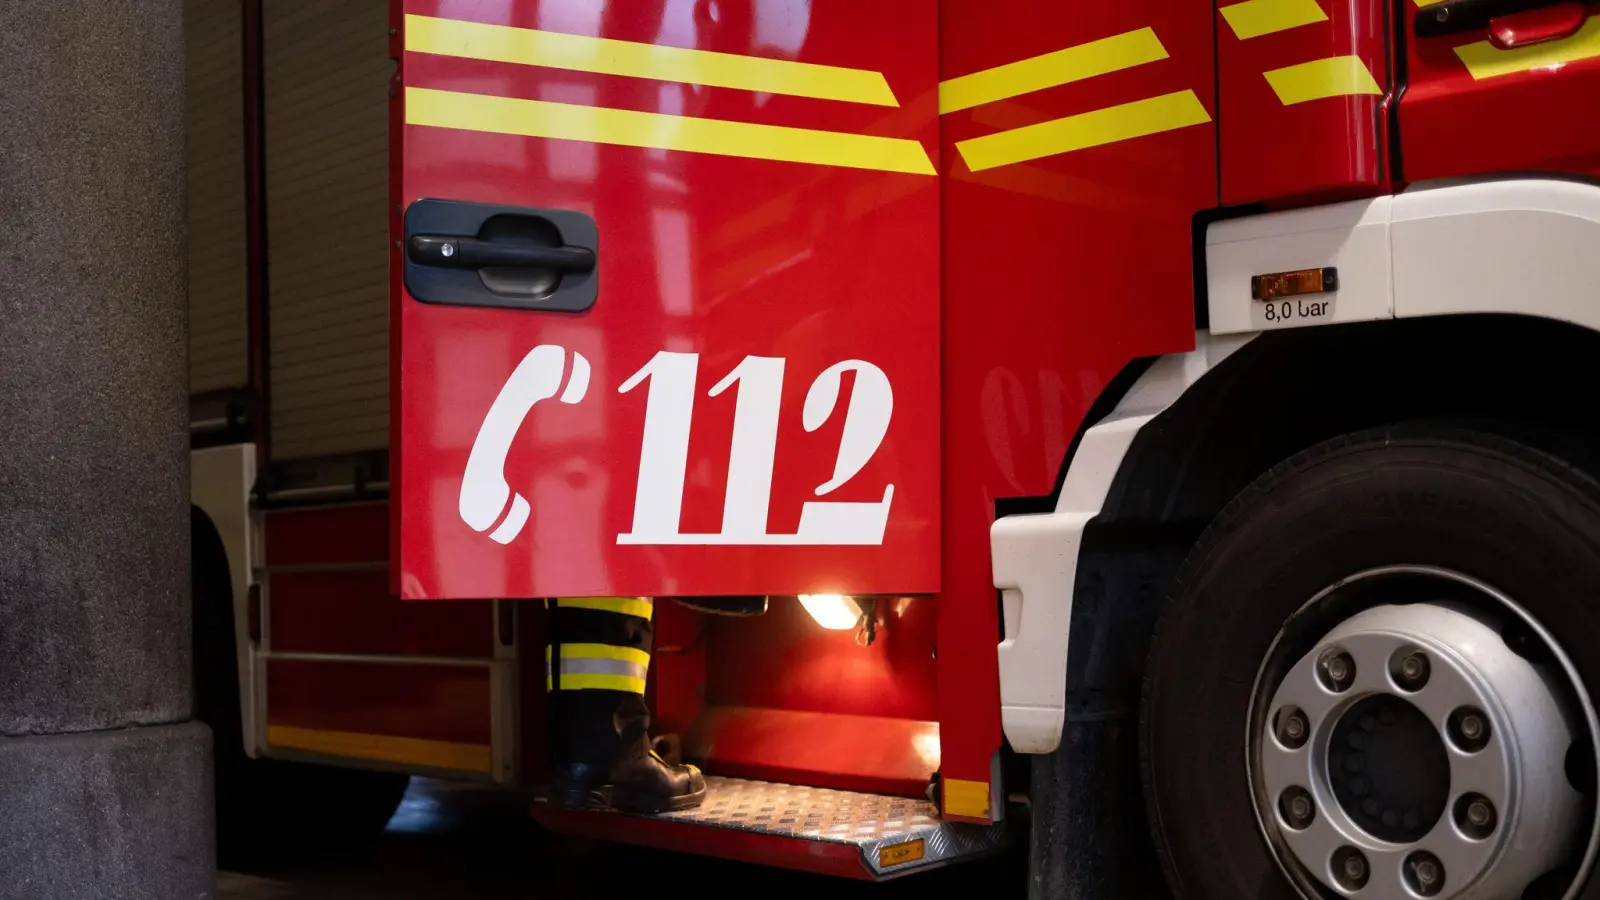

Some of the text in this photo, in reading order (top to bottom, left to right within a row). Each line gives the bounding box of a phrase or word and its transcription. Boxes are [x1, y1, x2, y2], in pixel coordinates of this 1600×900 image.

[1265, 300, 1329, 323] 8,0 bar
[616, 350, 895, 545] 112
